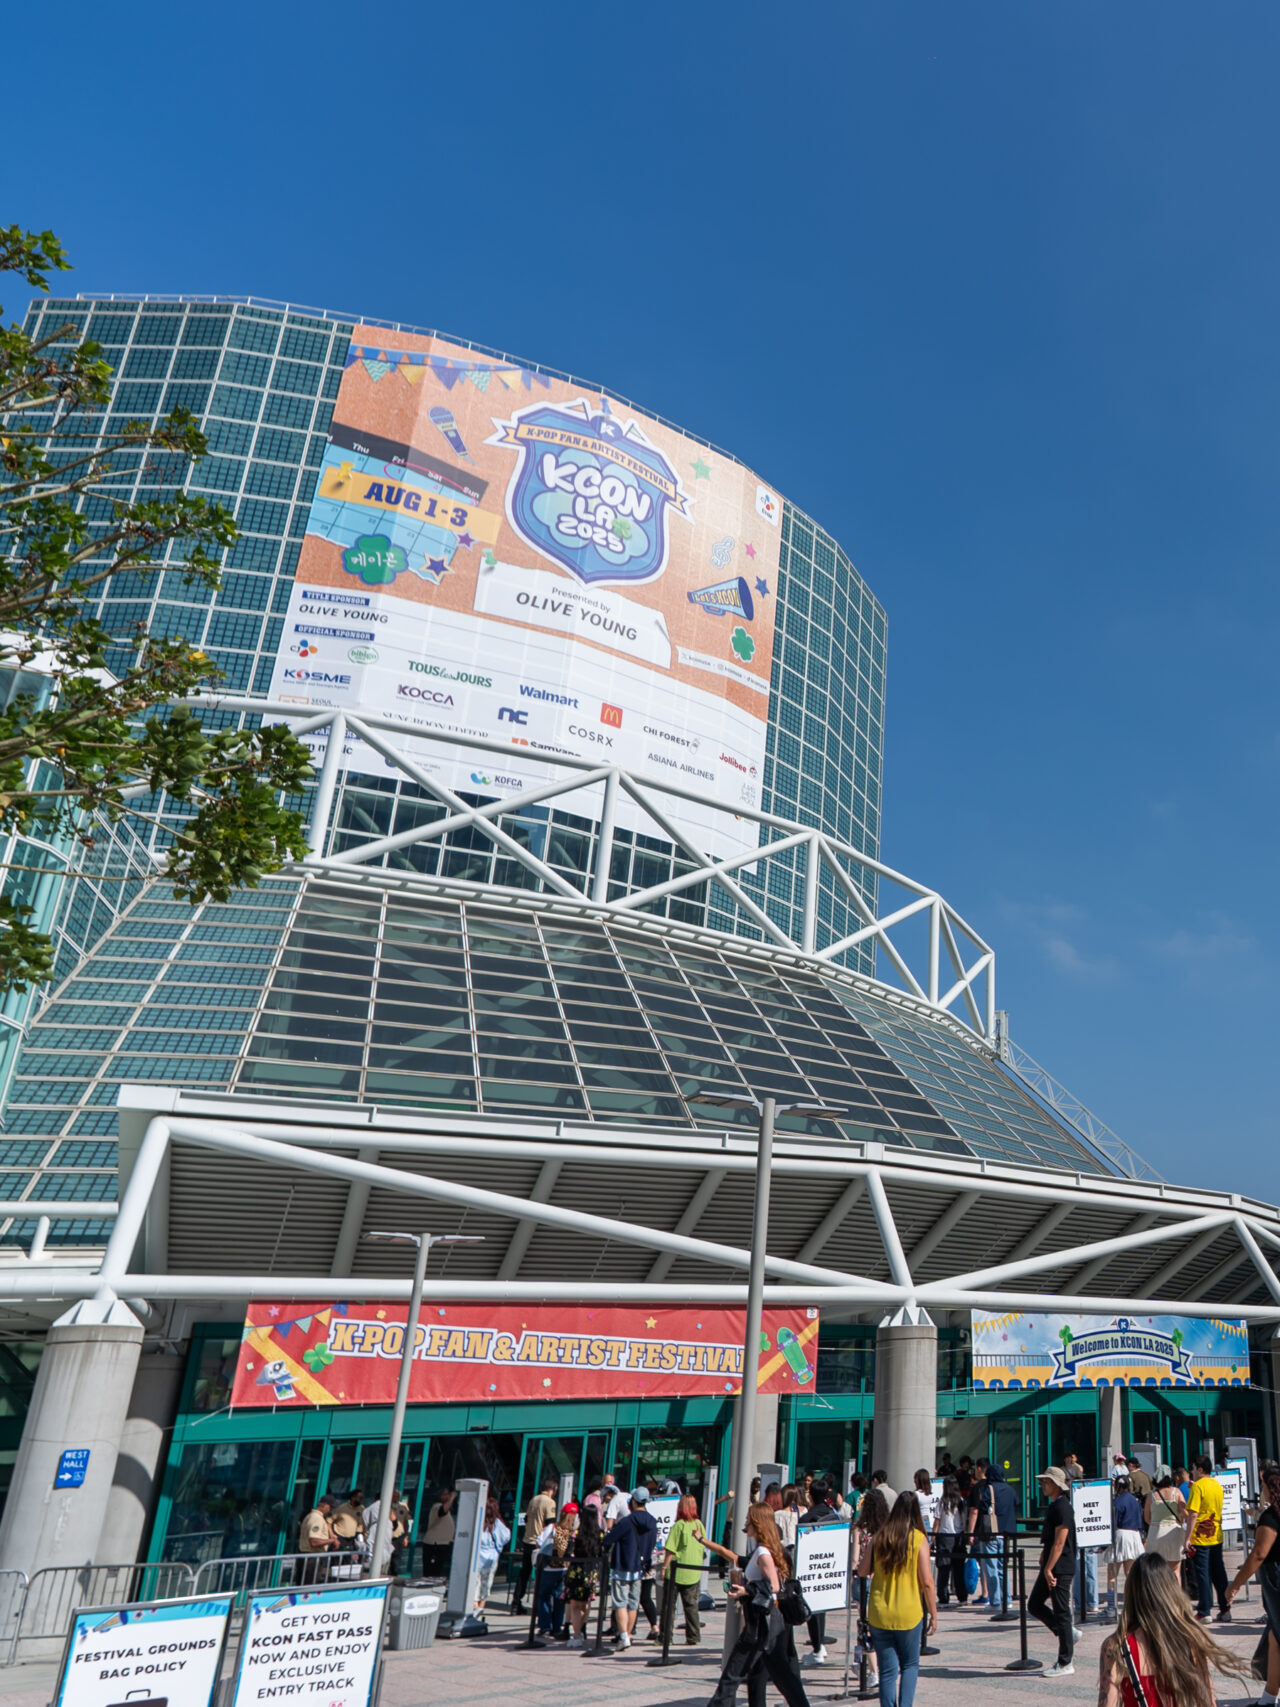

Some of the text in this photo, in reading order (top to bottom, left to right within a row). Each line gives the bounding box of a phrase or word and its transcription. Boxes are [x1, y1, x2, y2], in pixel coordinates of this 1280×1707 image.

[352, 442, 370, 454] Thu
[392, 456, 405, 464] Fri
[526, 428, 670, 492] K-POP FAN & ARTIST FESTIVAL
[428, 471, 443, 482] Sat
[364, 482, 423, 512] AUG
[462, 486, 480, 498] Sun
[542, 452, 651, 522] KCON
[574, 496, 617, 530] LA
[558, 515, 626, 554] 2025
[306, 591, 366, 605] TITLE SPONSOR
[552, 586, 610, 614] Presented by
[299, 604, 389, 624] OLIVE YOUNG
[516, 592, 638, 641] OLIVE YOUNG
[298, 625, 372, 640] OFFICIAL SPONSOR
[284, 668, 352, 685] KOSME
[398, 684, 454, 706] KOCCA
[520, 684, 580, 709] Walmart
[568, 724, 614, 748] COSRX
[643, 726, 690, 748] CHI FOREST
[648, 752, 714, 782] ASIANA AIRLINES
[719, 752, 747, 774] Jollibee
[494, 775, 523, 788] KOFCA
[426, 1326, 493, 1360] FAN
[493, 1336, 514, 1362] &
[518, 1334, 628, 1366] ARTIST
[1072, 1337, 1174, 1357] Welcome to KCON LA 2025
[62, 1460, 84, 1468] HALL
[65, 1450, 88, 1460] WEST
[1082, 1516, 1102, 1524] GREET
[1086, 1524, 1110, 1532] SESSION
[808, 1560, 836, 1570] STAGE /
[809, 1552, 834, 1560] DREAM
[824, 1570, 846, 1579] GREET
[812, 1582, 842, 1592] SESSION
[280, 1612, 350, 1628] GET YOUR
[252, 1626, 373, 1648] KCON FAST PASS
[75, 1638, 216, 1664] FESTIVAL GROUNDS
[248, 1642, 371, 1666] NOW AND ENJOY
[100, 1660, 187, 1680] BAG POLICY
[268, 1662, 346, 1681] EXCLUSIVE
[257, 1676, 355, 1699] ENTRY TRACK
